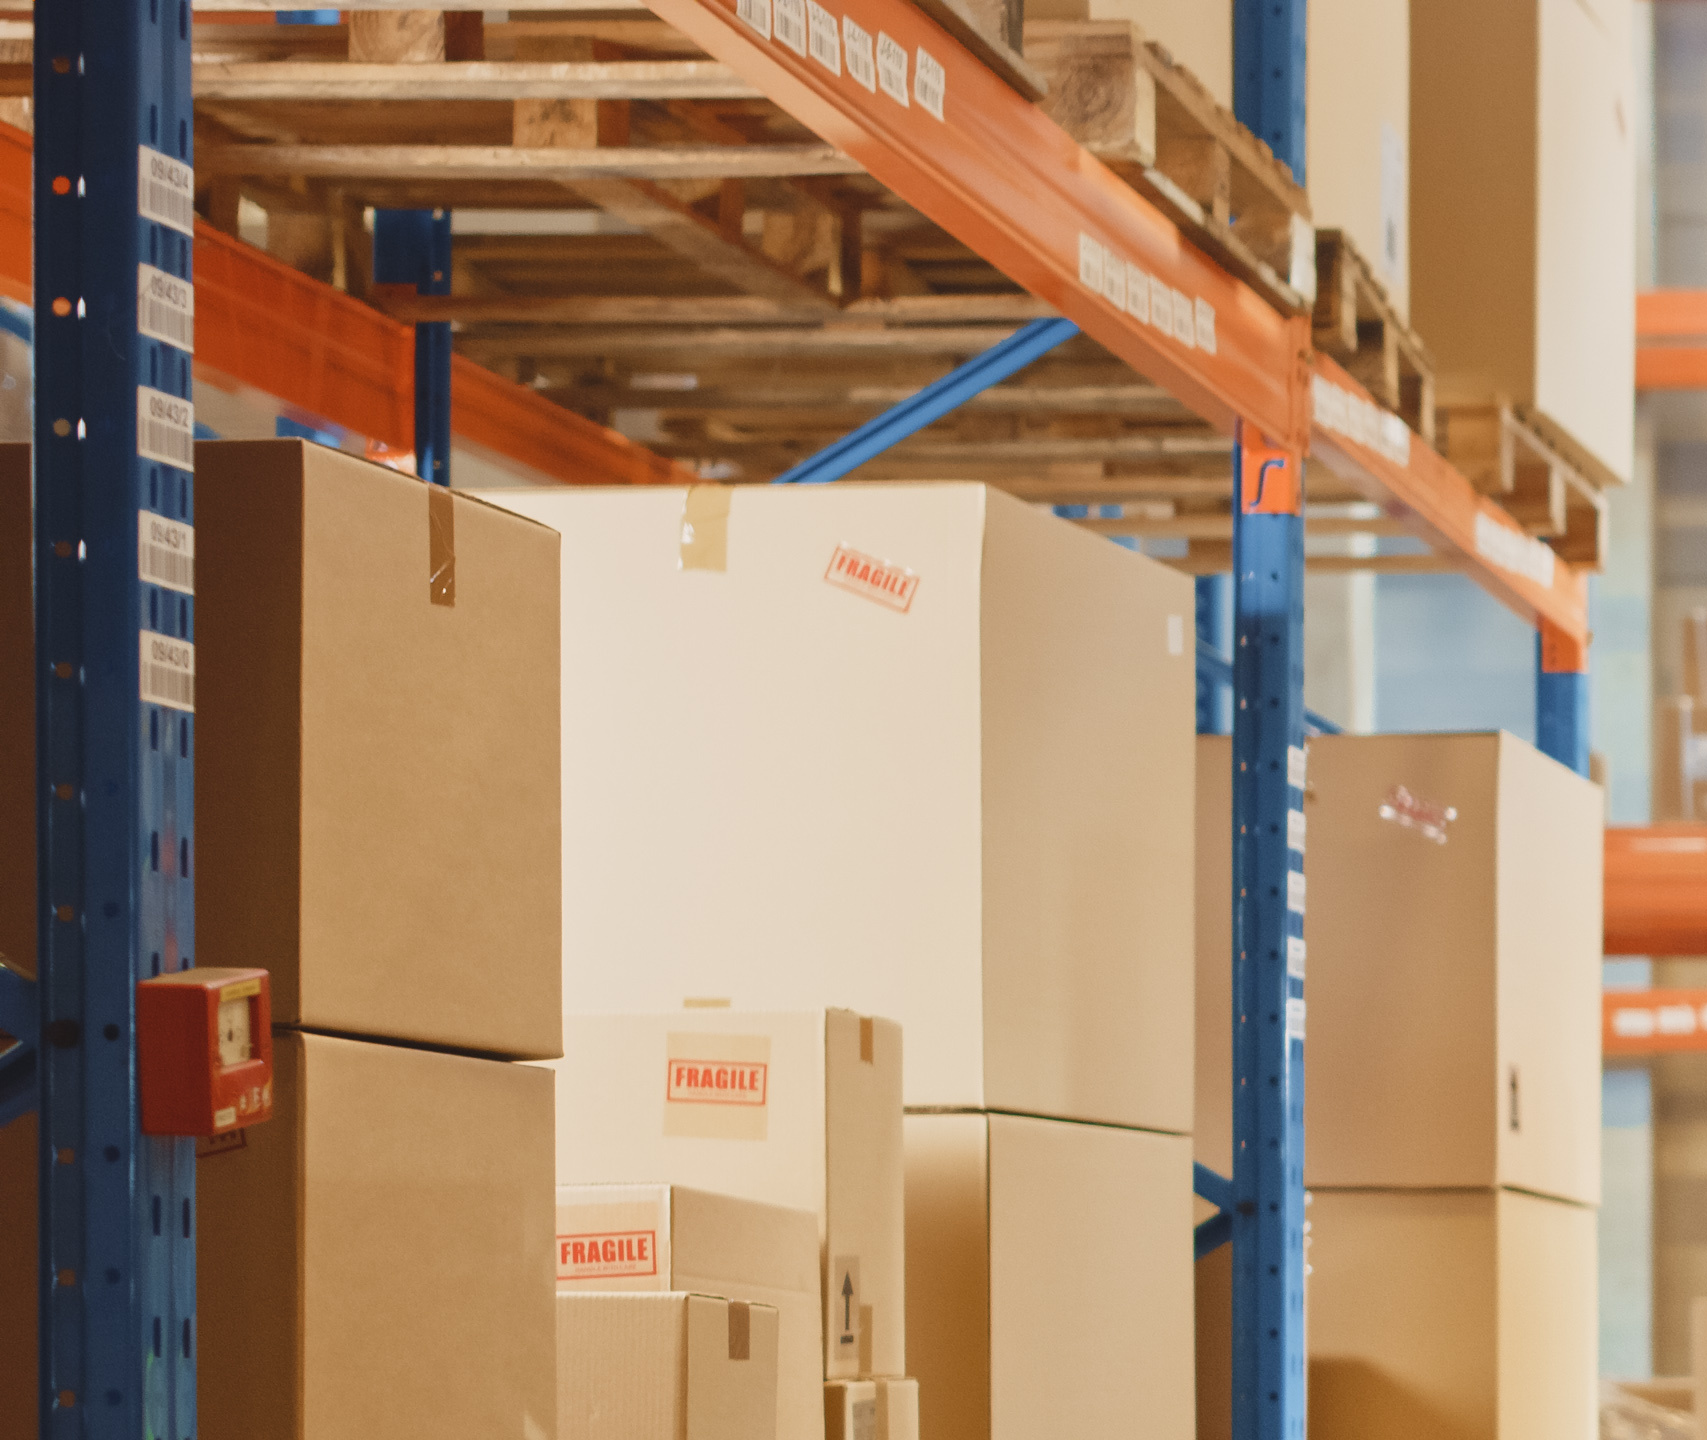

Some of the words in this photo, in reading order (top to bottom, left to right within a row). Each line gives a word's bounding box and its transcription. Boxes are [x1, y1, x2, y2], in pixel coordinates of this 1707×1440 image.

[836, 553, 909, 598] FRAGILE
[675, 1066, 759, 1091] FRAGILE
[560, 1237, 649, 1265] FRAGILE
